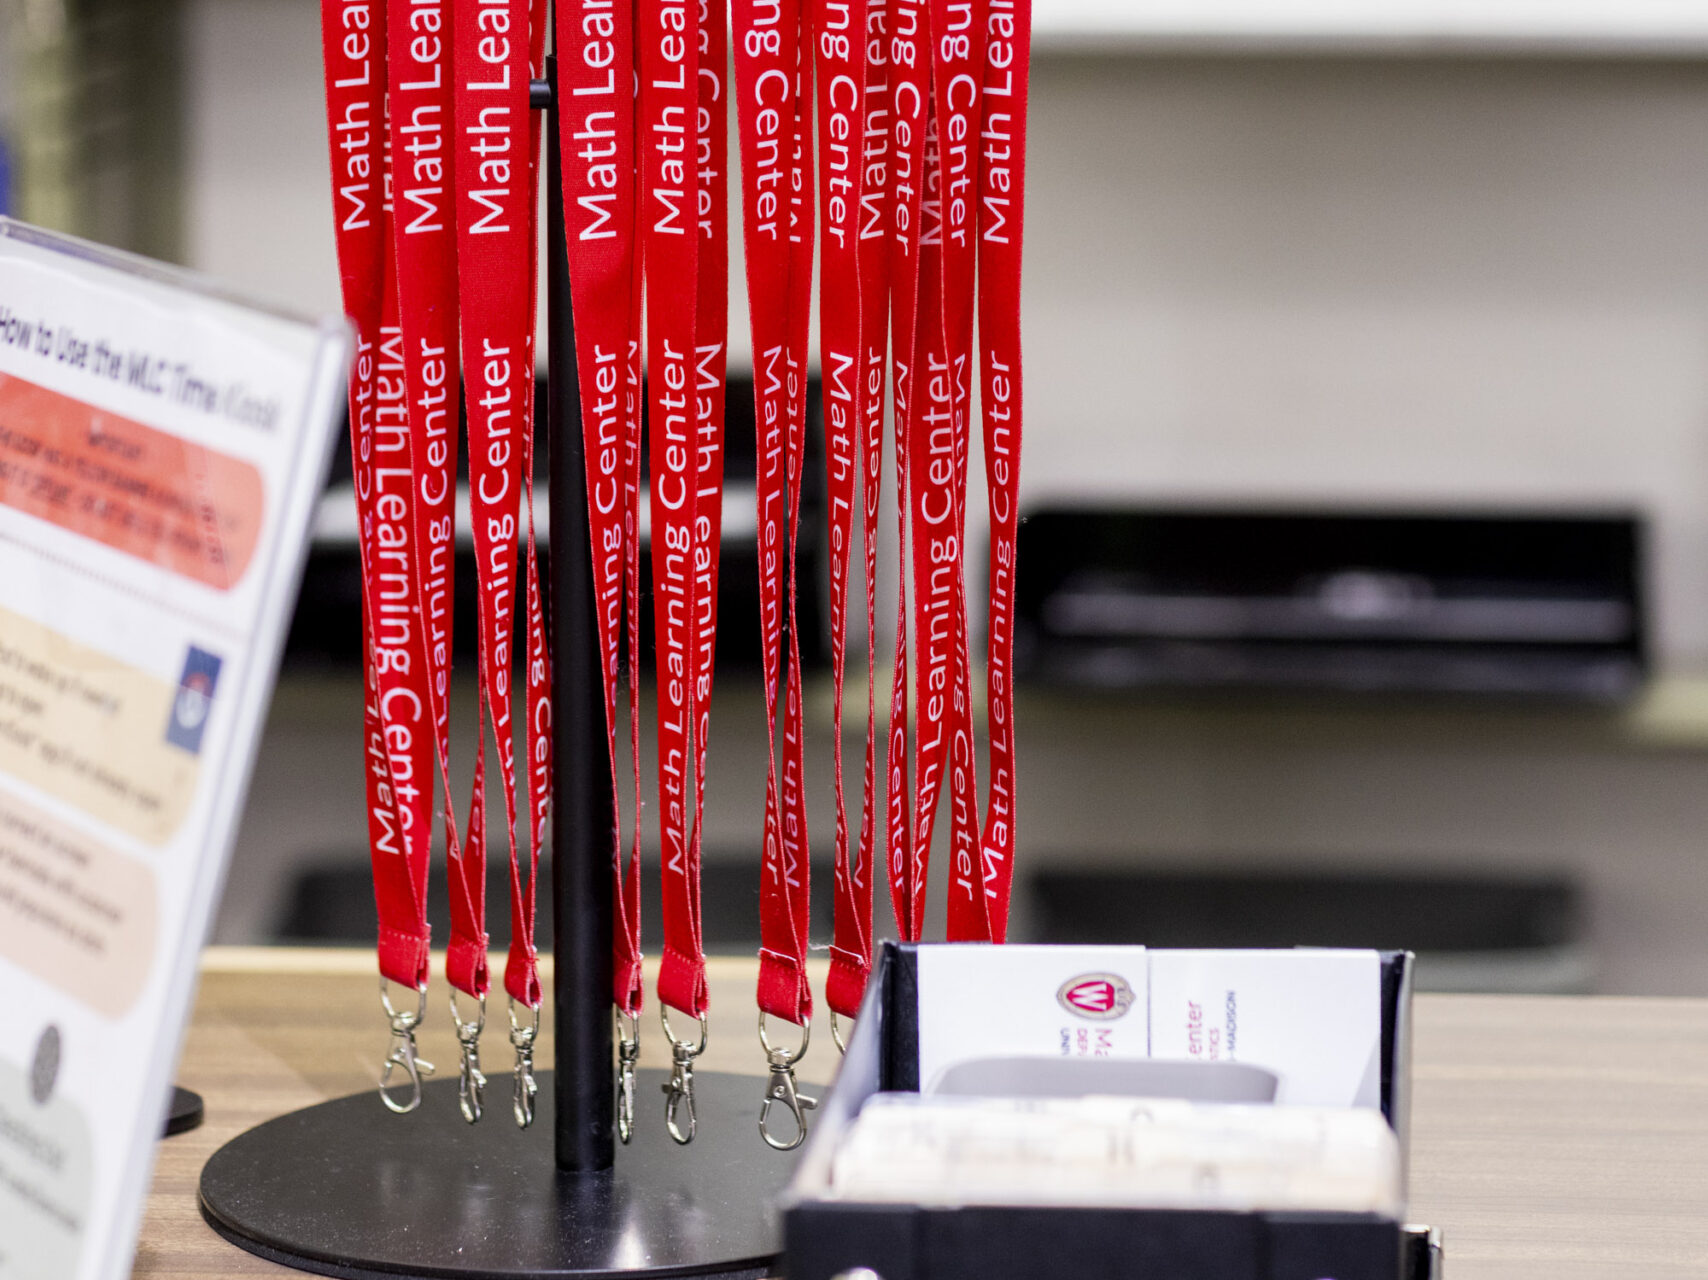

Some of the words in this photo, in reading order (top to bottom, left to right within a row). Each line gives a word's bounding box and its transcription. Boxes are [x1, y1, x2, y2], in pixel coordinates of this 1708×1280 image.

[335, 101, 370, 231] Math
[400, 105, 443, 235] Math
[466, 107, 510, 235] Math
[573, 111, 617, 241] Math
[653, 106, 685, 236] Math
[754, 69, 789, 241] Center
[829, 74, 858, 249] Center
[860, 109, 889, 241] Math
[895, 81, 921, 257] Center
[947, 73, 977, 247] Center
[980, 110, 1011, 245] Math
[417, 337, 448, 507] Center
[479, 337, 510, 506] Center
[592, 344, 618, 516] Center
[658, 338, 686, 511] Center
[695, 342, 723, 474] Math
[763, 345, 782, 479] Math
[829, 351, 854, 482] Math
[865, 347, 883, 519] Center
[921, 352, 954, 526] Center
[988, 350, 1010, 525] Center
[375, 468, 420, 676] Learning
[424, 515, 450, 726] Learning
[486, 512, 514, 728] Learning
[661, 522, 690, 736] Learning
[923, 534, 957, 752] Learning
[989, 538, 1011, 753] Learning
[367, 731, 400, 855] Math
[663, 748, 686, 877] Math
[784, 761, 801, 889] Math
[914, 764, 938, 896] Math
[953, 727, 974, 901] Center
[982, 768, 1009, 900] Math
